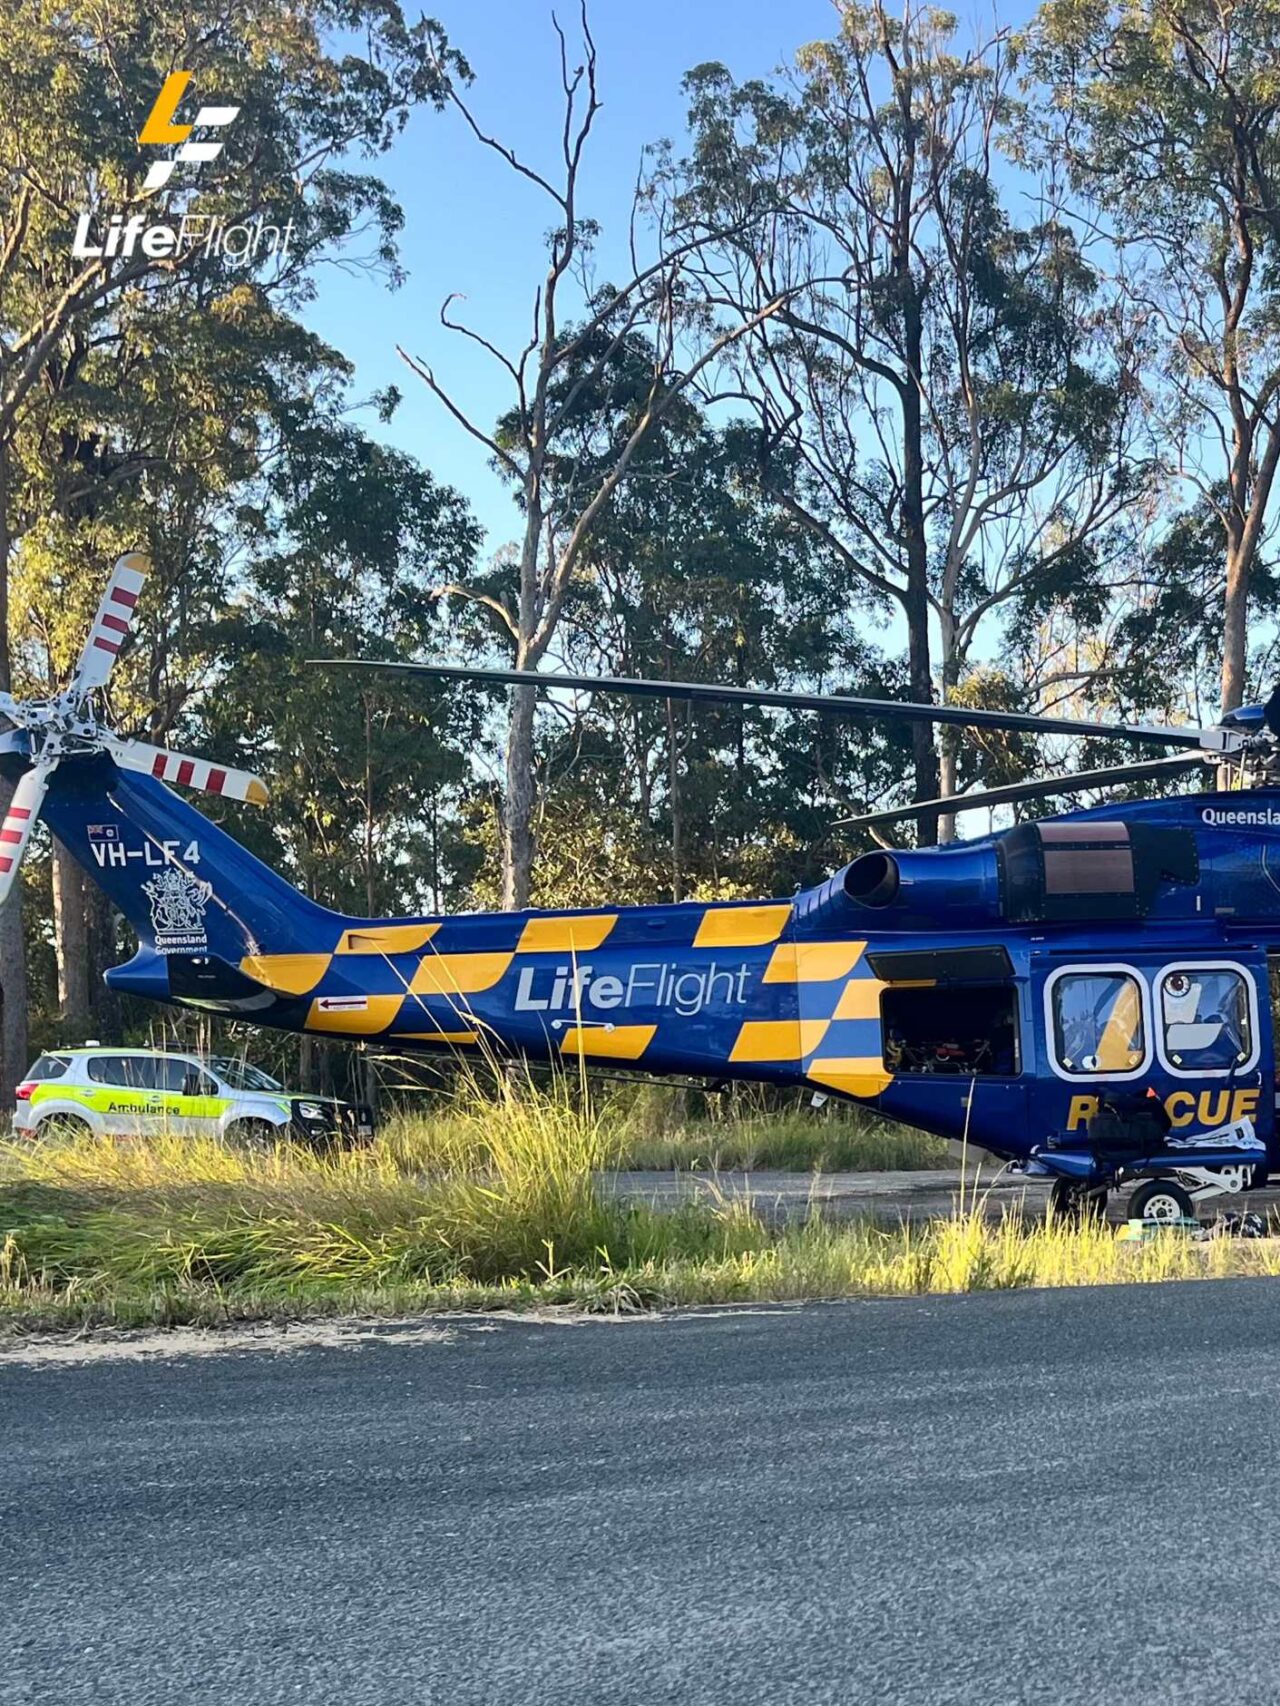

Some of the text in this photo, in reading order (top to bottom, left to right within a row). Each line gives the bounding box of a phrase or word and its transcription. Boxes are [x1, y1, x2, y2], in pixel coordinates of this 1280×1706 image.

[91, 840, 201, 867] VH-LF4
[155, 935, 208, 945] Queensland
[514, 962, 752, 1016] LifeFlight
[108, 1102, 180, 1115] Ambulance
[1066, 1088, 1260, 1131] RCUE
